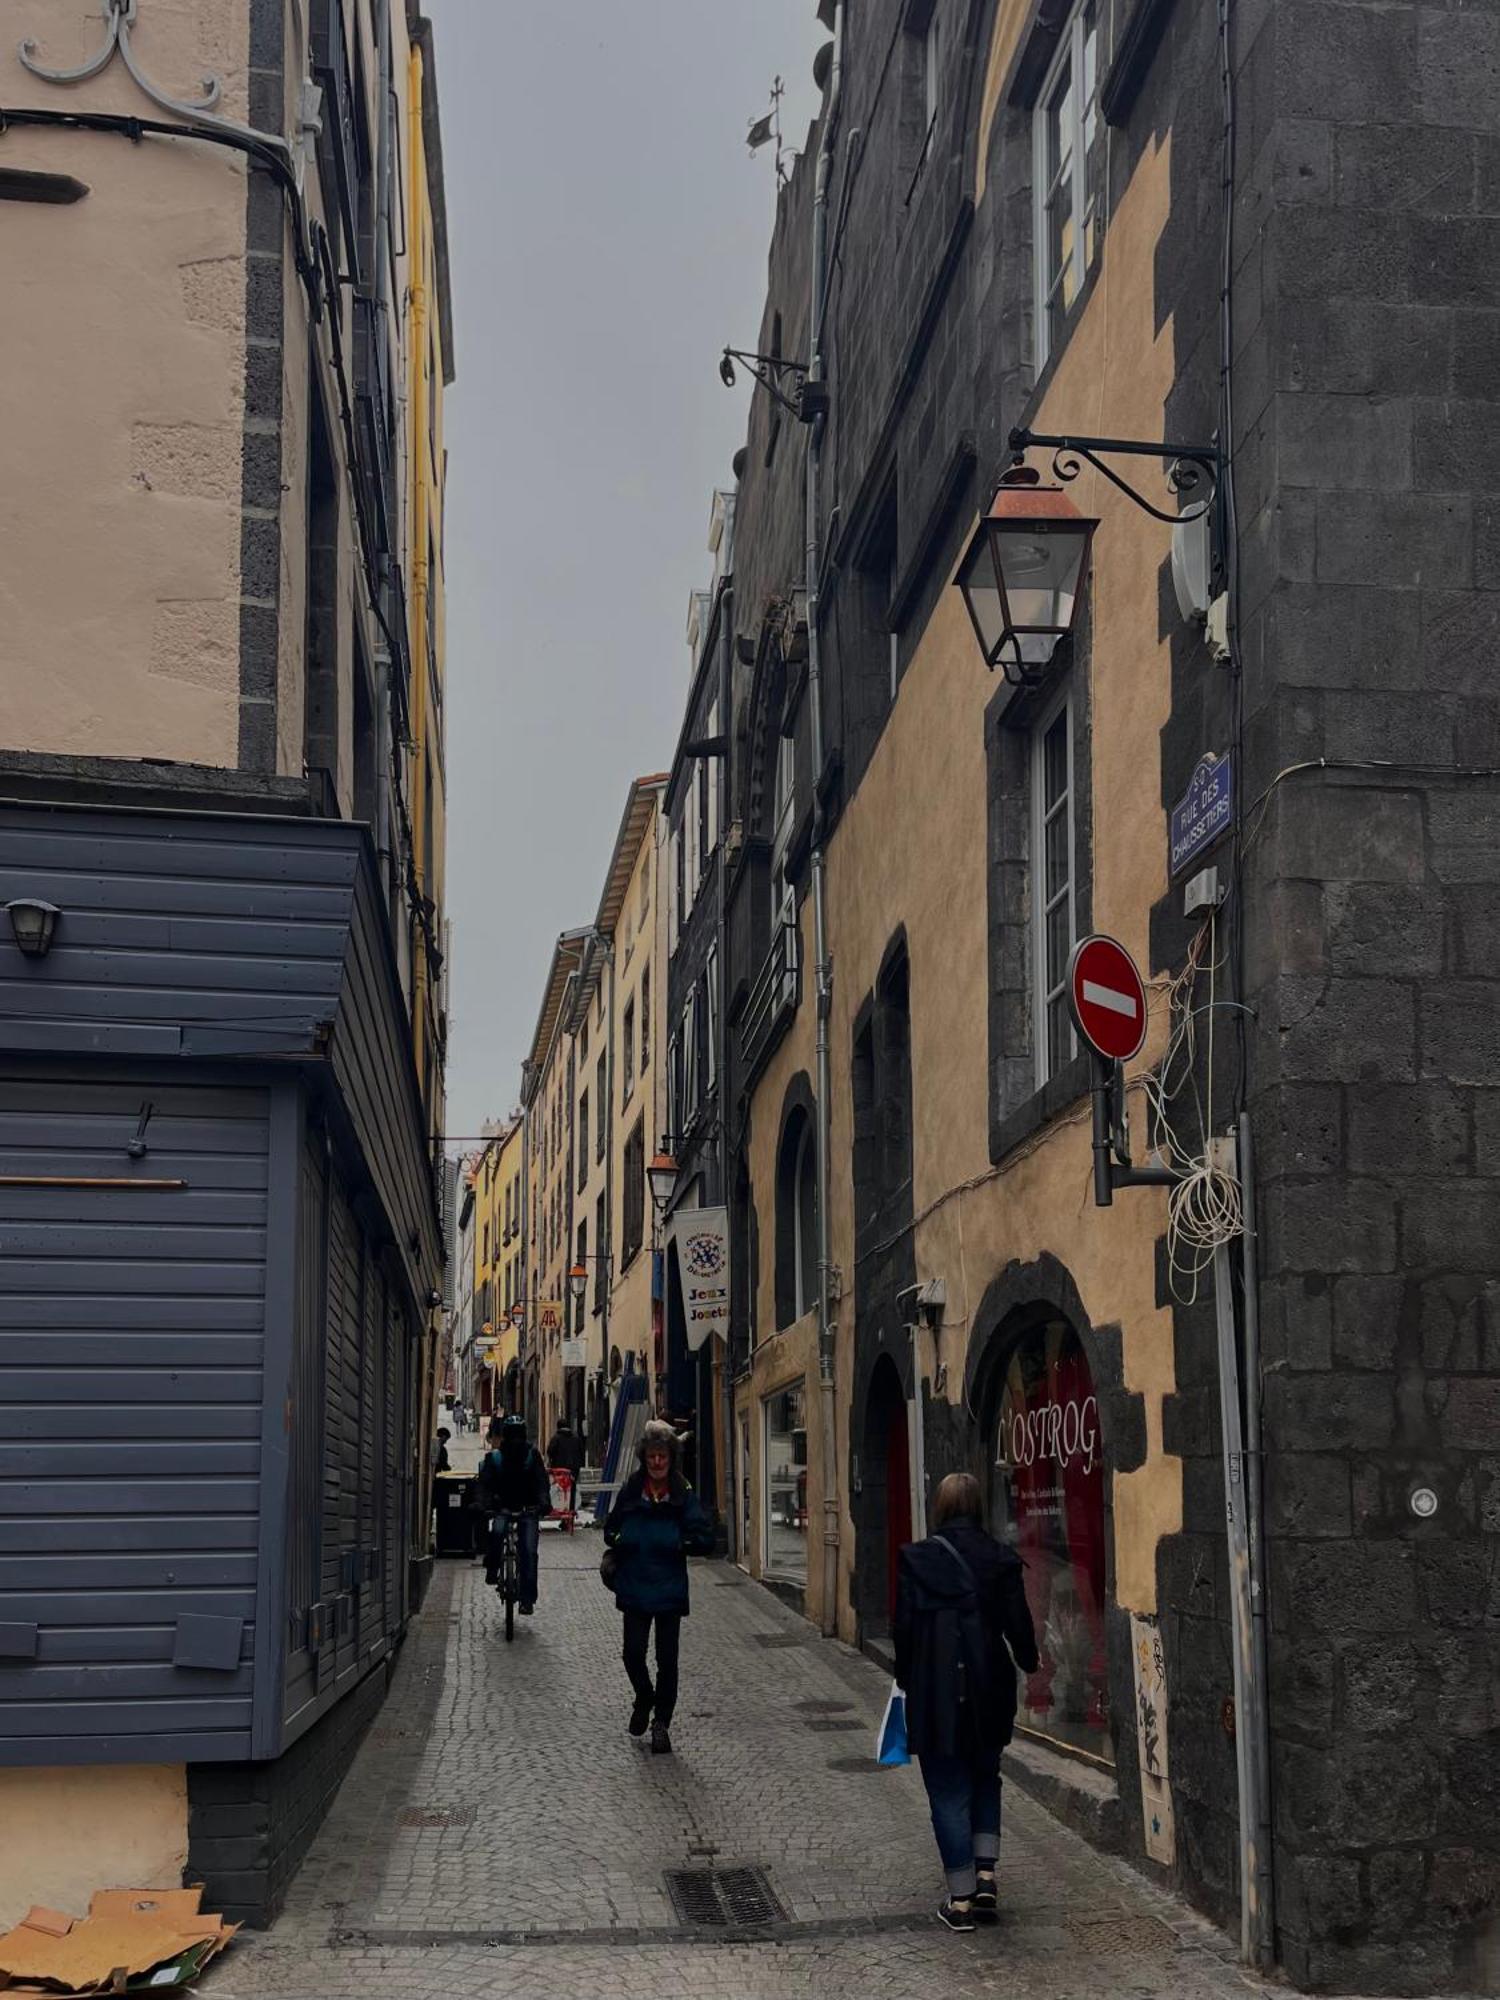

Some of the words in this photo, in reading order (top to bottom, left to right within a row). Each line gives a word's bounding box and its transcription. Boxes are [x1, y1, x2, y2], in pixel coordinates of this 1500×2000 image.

[1173, 794, 1229, 863] CHAUSSETIERS
[1180, 799, 1198, 831] RUE
[1201, 778, 1219, 809] DES
[994, 1396, 1097, 1475] L'OSTROG
